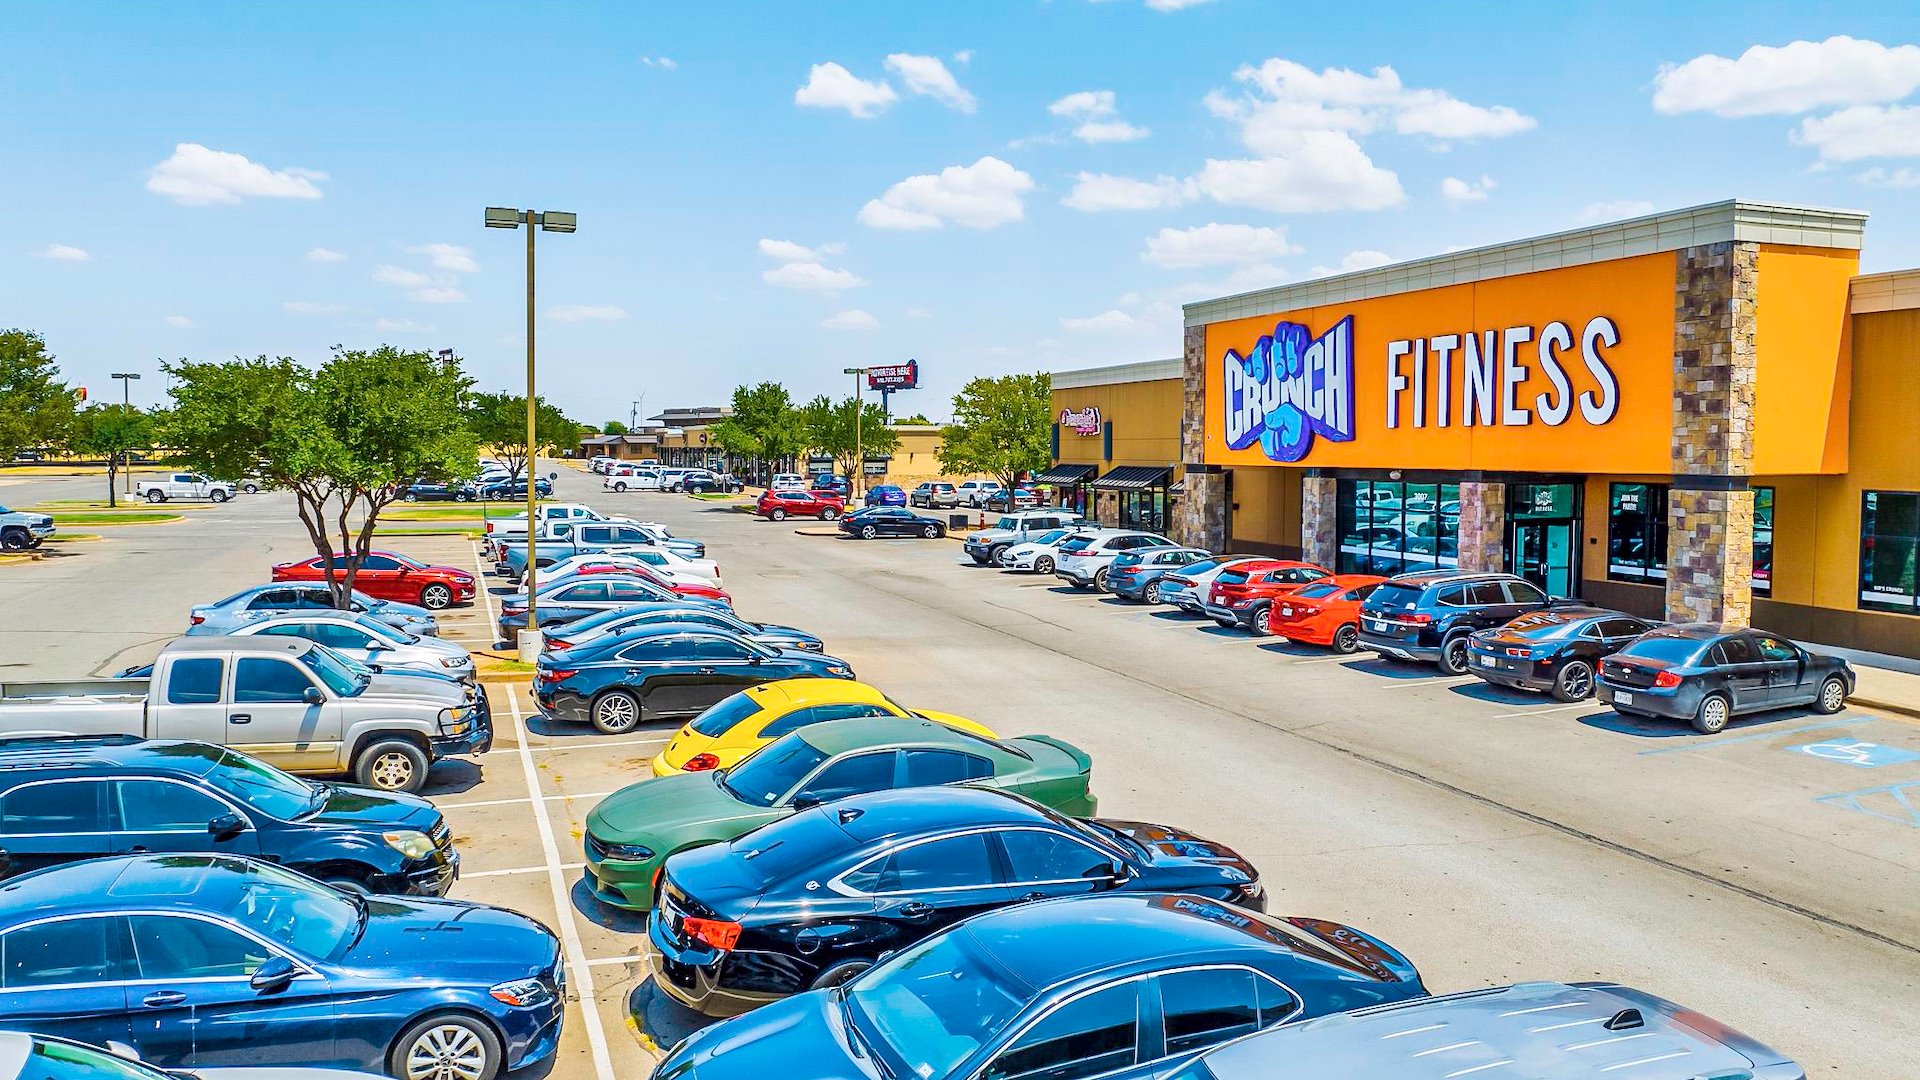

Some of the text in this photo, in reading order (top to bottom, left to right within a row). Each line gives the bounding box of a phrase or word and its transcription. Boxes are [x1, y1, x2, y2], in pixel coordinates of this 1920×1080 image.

[897, 366, 910, 375] HERE
[1225, 316, 1620, 445] CRUNCH FITNESS
